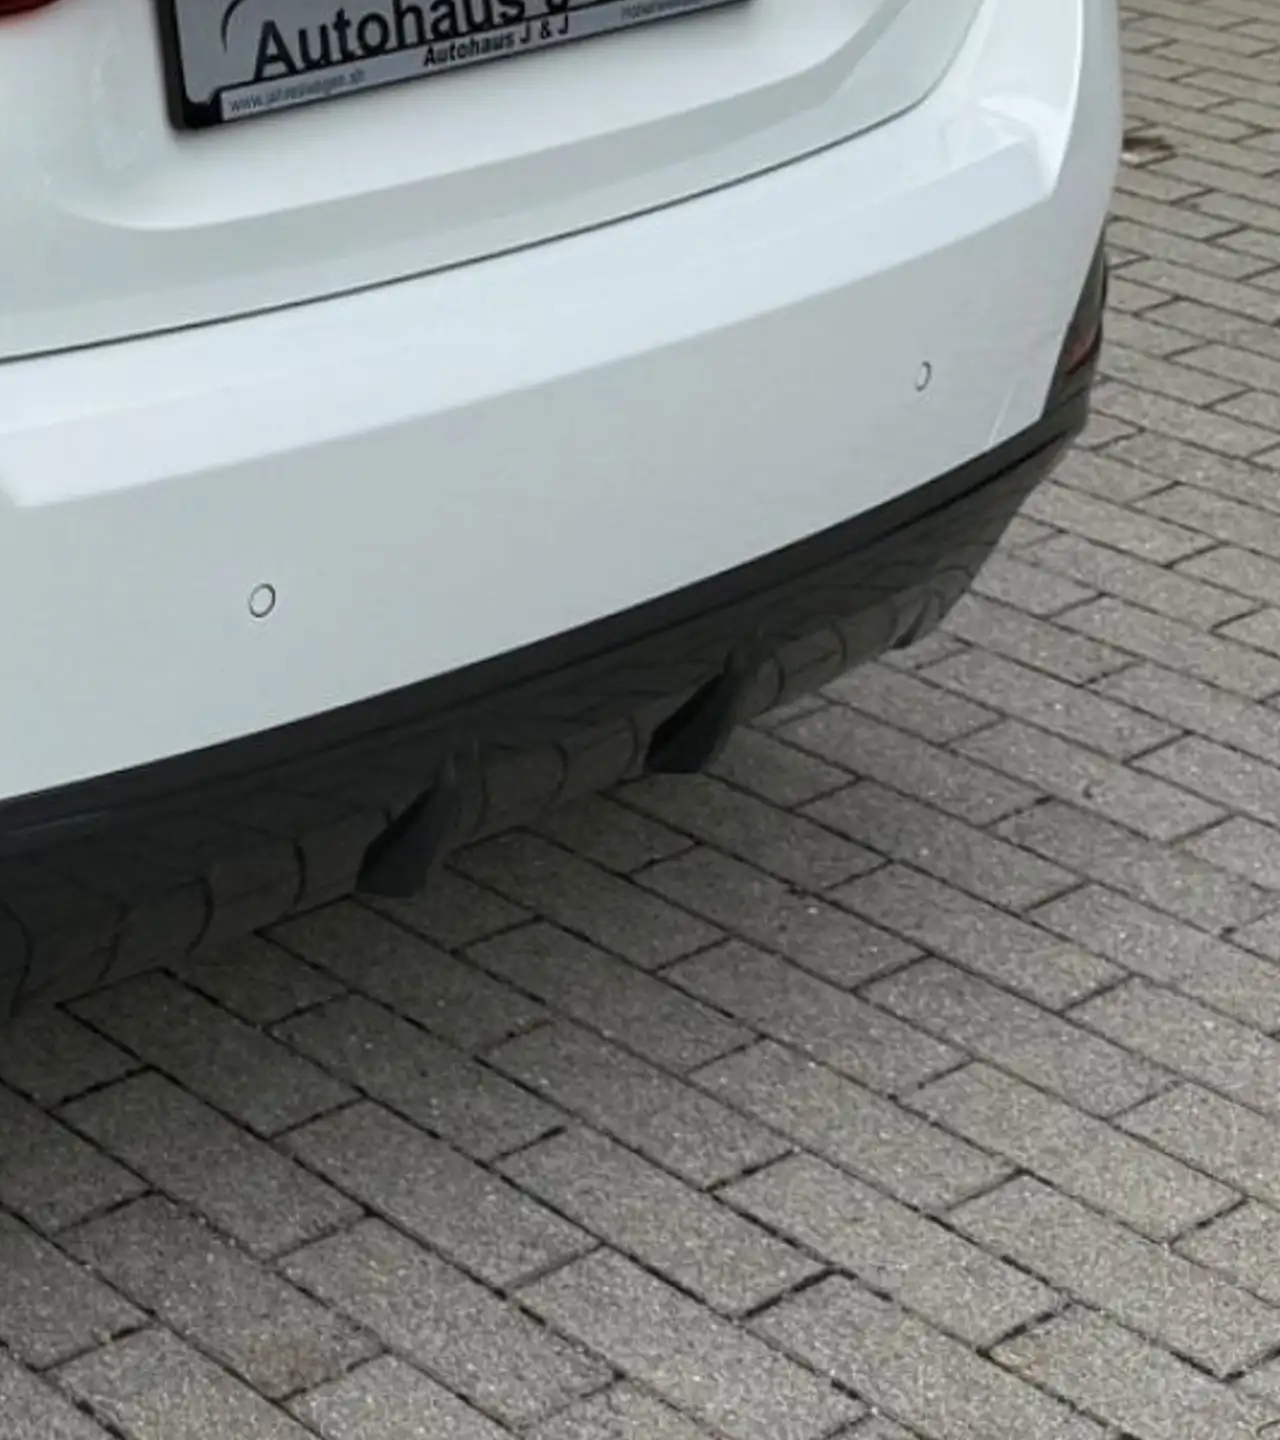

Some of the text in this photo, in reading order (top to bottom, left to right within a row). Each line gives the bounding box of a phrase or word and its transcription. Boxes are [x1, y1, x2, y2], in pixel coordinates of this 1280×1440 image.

[423, 13, 569, 67] Autohaus J & J
